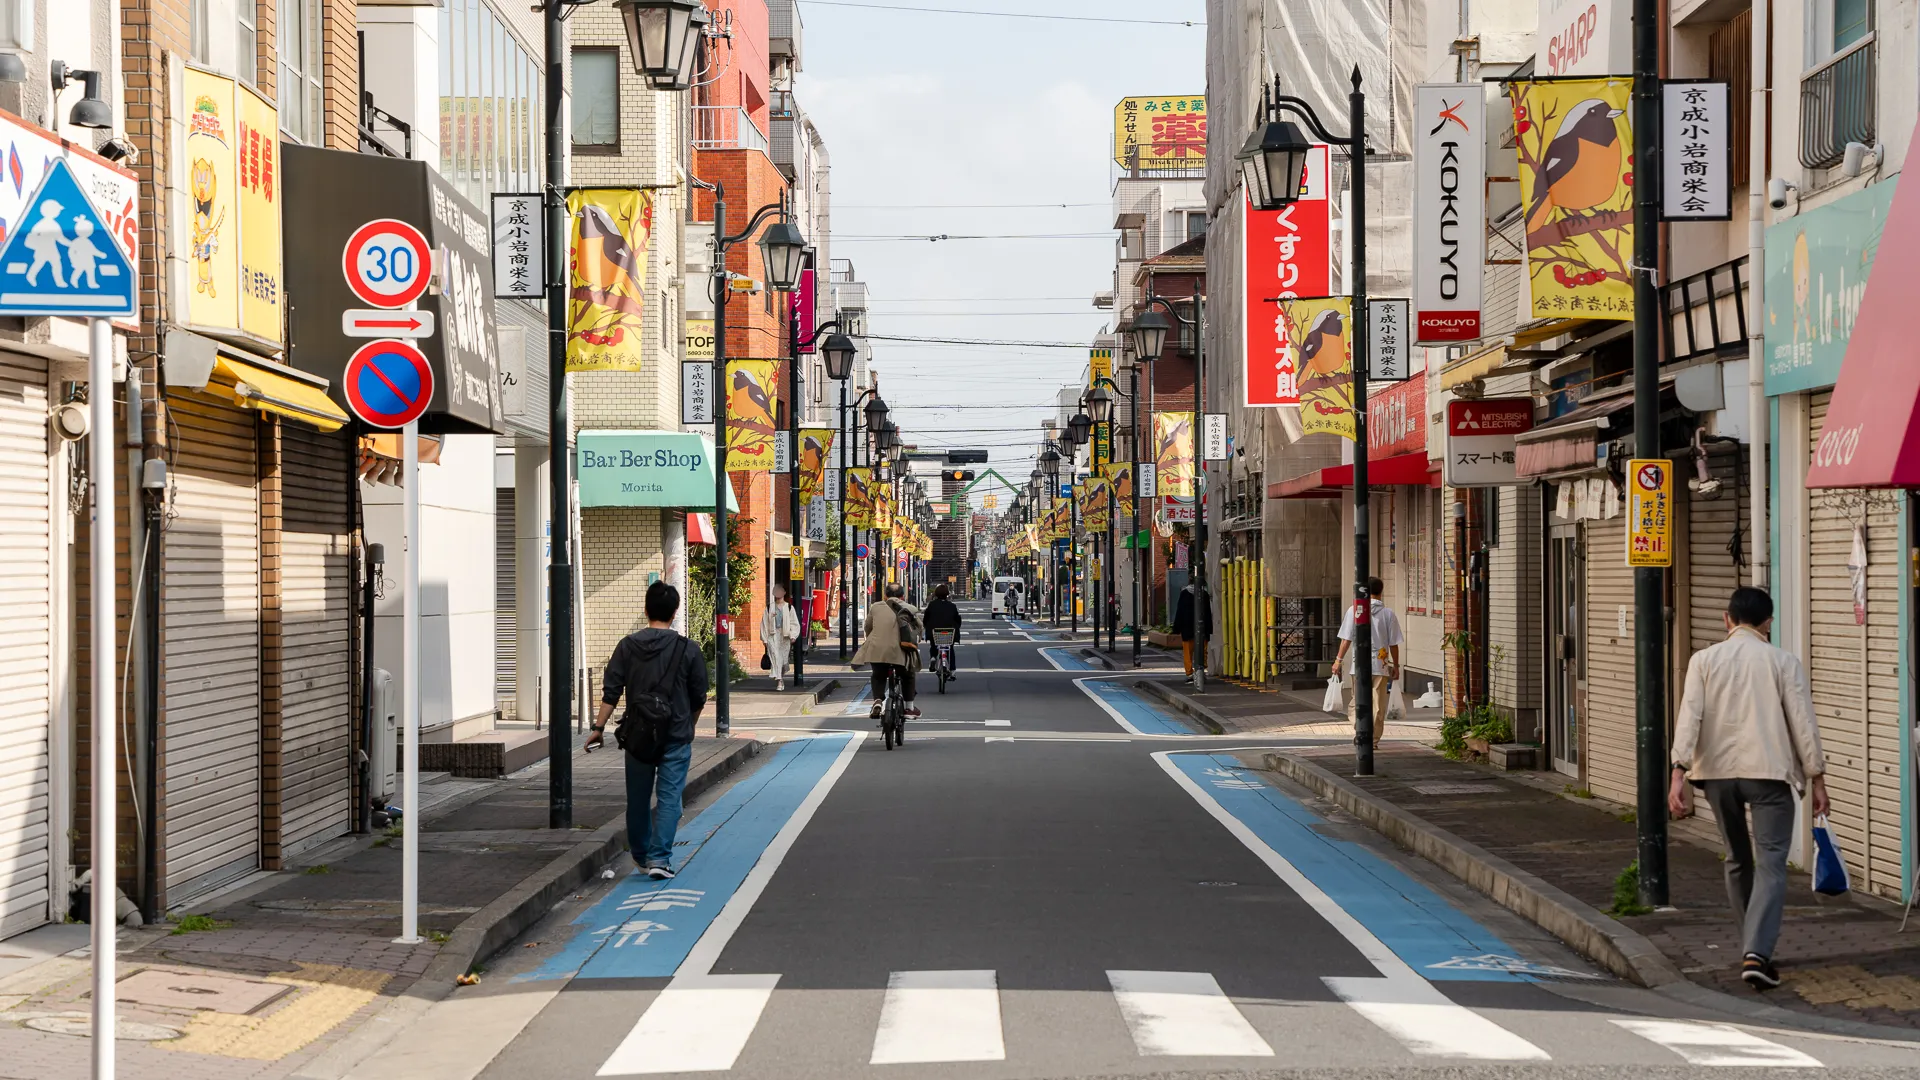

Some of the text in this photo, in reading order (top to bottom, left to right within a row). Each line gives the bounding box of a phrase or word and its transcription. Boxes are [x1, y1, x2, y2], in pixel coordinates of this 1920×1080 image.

[1547, 4, 1597, 76] SHARP
[1680, 88, 1710, 213] 京成小岩商栄会
[1440, 142, 1459, 300] KOKUYO
[366, 246, 413, 282] 30
[508, 200, 531, 293] 京成小岩商栄会
[242, 264, 276, 304] 成小岩商栄会
[1379, 304, 1398, 377] 京成小岩商栄会
[1422, 318, 1476, 327] KOKUYO
[566, 352, 640, 367] 成小岩商栄会
[686, 336, 714, 348] TOP
[692, 364, 705, 421] 京成小岩商栄会
[1482, 412, 1528, 421] MITSUBISHI
[1482, 420, 1522, 429] ELECTRIC
[776, 432, 785, 471] 京成小岩商栄会
[1210, 415, 1220, 458] 京成小岩商栄会
[1457, 452, 1515, 465] スマート電
[621, 482, 663, 493] Morita
[1643, 500, 1653, 534] ポイ捨て
[1656, 492, 1667, 534] 歩きたばこ
[1635, 536, 1667, 552] 禁止
